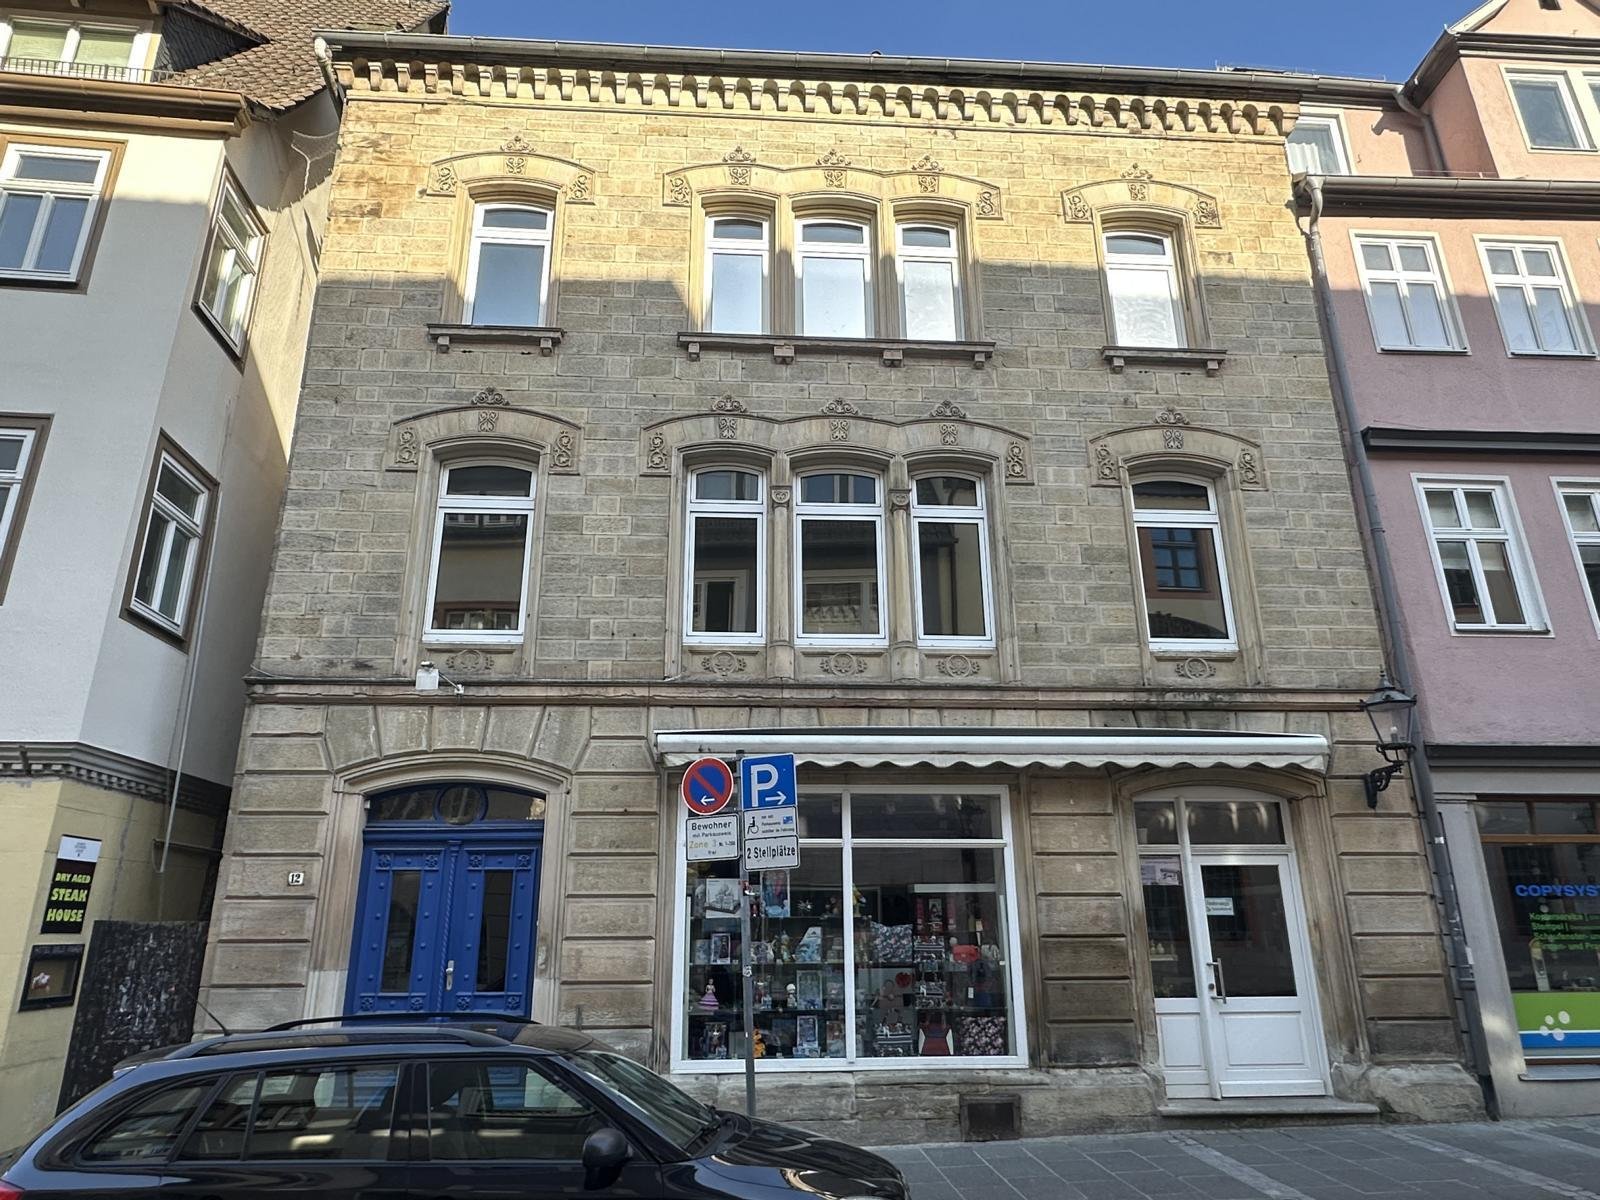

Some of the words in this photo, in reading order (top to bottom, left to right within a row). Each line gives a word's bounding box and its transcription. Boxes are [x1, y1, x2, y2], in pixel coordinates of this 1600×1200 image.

[750, 763, 779, 808] P
[691, 821, 732, 831] Bewohner
[689, 840, 709, 849] Zone
[746, 847, 752, 859] 2
[753, 844, 796, 859] Stellplätze
[55, 872, 71, 882] DRY
[71, 874, 91, 884] AGED
[290, 873, 301, 884] 12
[50, 887, 88, 902] STEAK
[46, 908, 84, 922] HOUSE
